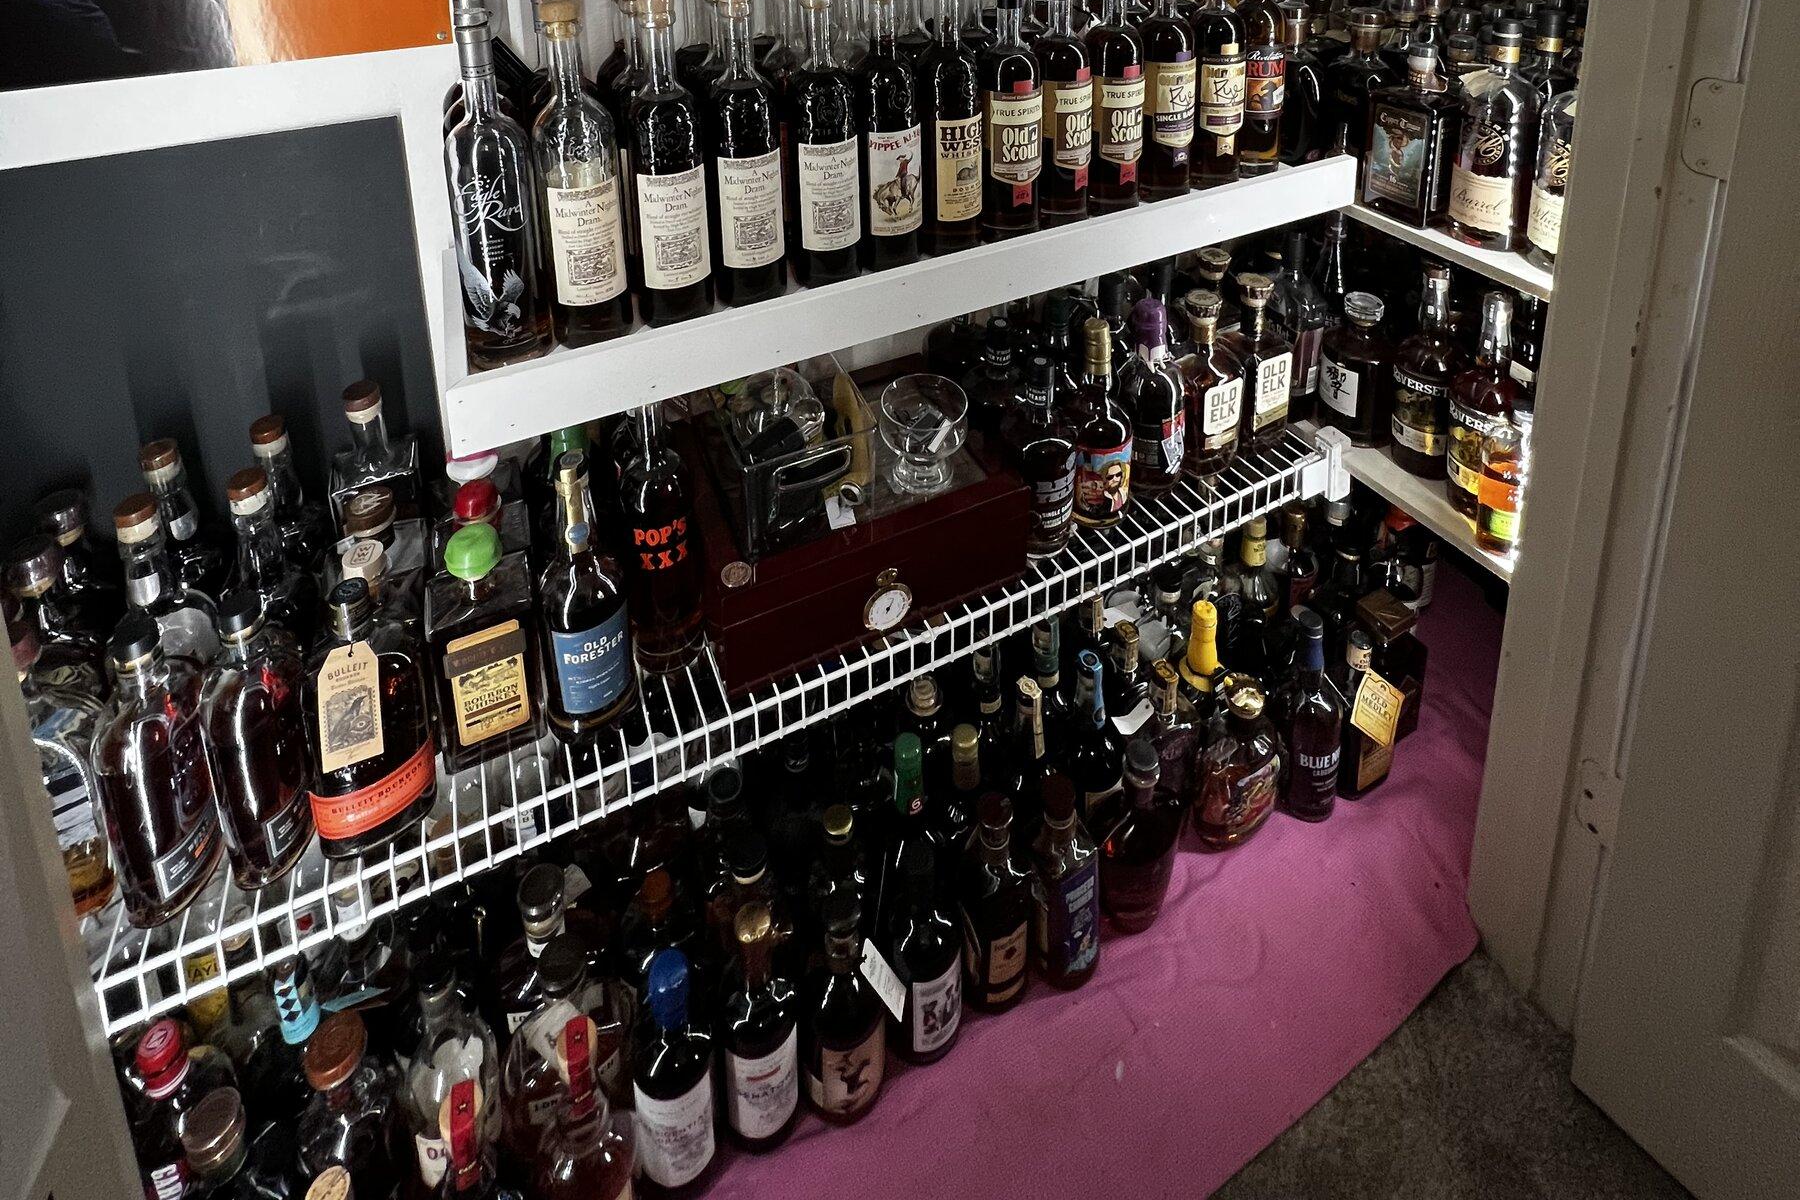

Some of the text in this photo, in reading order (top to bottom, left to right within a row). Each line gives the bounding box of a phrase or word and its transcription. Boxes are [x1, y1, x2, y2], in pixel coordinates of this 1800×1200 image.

[1248, 60, 1284, 77] RUM
[1106, 90, 1125, 98] TRUE
[1169, 86, 1196, 111] Rye
[1213, 78, 1244, 102] Rye
[1059, 97, 1077, 105] TRUE
[1066, 113, 1087, 133] Old
[1111, 109, 1135, 127] Old
[1156, 113, 1182, 122] SINGLE
[868, 140, 902, 152] YIPPEE
[940, 136, 982, 152] WES
[1002, 127, 1028, 148] Old
[1066, 130, 1092, 149] Scou
[1002, 140, 1038, 163] Scout
[804, 161, 841, 171] Midwinter
[724, 175, 761, 185] Midwinter
[823, 171, 843, 180] Dram
[644, 192, 684, 203] Midwinter
[744, 185, 765, 194] Dram
[1454, 185, 1503, 212] Barrel
[555, 207, 596, 218] Midwinter
[665, 202, 688, 212] Dram
[577, 216, 601, 227] Dram
[1263, 359, 1287, 379] OLD
[1262, 375, 1285, 395] ELK
[1211, 386, 1237, 408] OLD
[1210, 403, 1236, 424] ELK
[633, 516, 687, 547] POP'S
[564, 630, 624, 665] FORESTER
[583, 636, 608, 652] OLD
[327, 662, 369, 681] BULLEIT
[464, 682, 519, 708] BOURBON
[465, 689, 519, 713] WHISKEY
[1370, 692, 1388, 709] OLD
[1361, 695, 1393, 721] MEDLEY
[1299, 753, 1330, 769] BLUE
[377, 762, 423, 798] BOURBON
